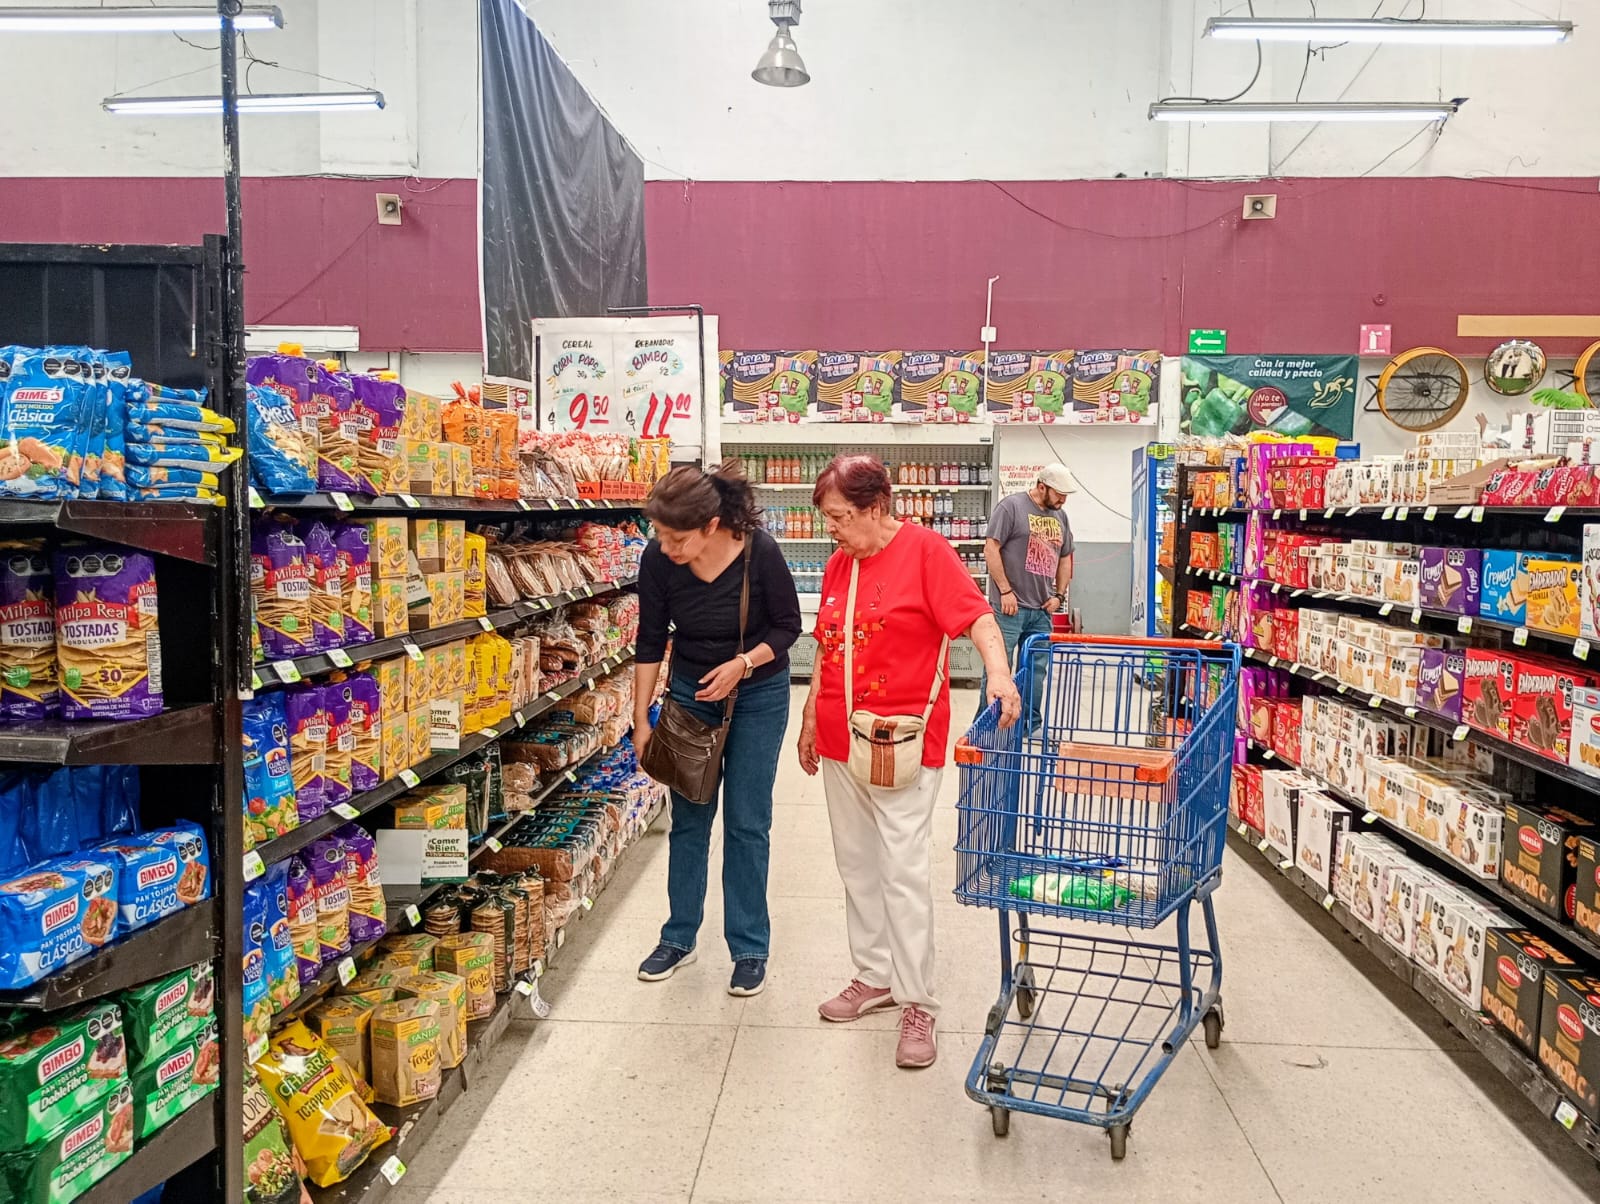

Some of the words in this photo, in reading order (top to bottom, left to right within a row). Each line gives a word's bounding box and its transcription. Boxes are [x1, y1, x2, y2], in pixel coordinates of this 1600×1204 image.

[562, 339, 593, 349] CEREAL
[553, 353, 573, 376] CORN
[632, 350, 668, 371] BIMBO
[1254, 360, 1273, 368] Con
[1274, 360, 1285, 368] la
[1286, 360, 1316, 370] mejor
[1248, 368, 1284, 377] calidad
[1284, 369, 1291, 379] y
[1292, 368, 1323, 379] precio
[9, 409, 55, 424] Clásico
[547, 407, 556, 432] $
[569, 392, 589, 431] 9
[592, 395, 610, 416] 50
[625, 405, 636, 432] $
[640, 392, 674, 440] 11
[675, 392, 691, 413] 00
[274, 566, 301, 580] Milpa
[1529, 567, 1567, 592] EMPERADOR
[0, 604, 40, 621] Milpa
[59, 605, 91, 622] Milpa
[97, 602, 127, 620] Real
[64, 622, 119, 639] TOSTADAS
[67, 637, 116, 646] ONDULADAS
[98, 670, 122, 682] 30
[140, 861, 176, 884] BIMBO
[135, 894, 151, 904] PAN
[151, 883, 178, 899] TOSTADO
[45, 901, 76, 928] BIMBO
[135, 893, 177, 920] CLÁSICO
[41, 939, 53, 950] PAN
[56, 923, 81, 942] TOSTADO
[39, 935, 83, 968] CLÁSICO
[158, 983, 186, 1012] BIMBO
[42, 1042, 81, 1077] BIMBO
[160, 1052, 193, 1081] BIMBO
[41, 1085, 55, 1096] PAN
[57, 1063, 86, 1085] TOSTADO
[296, 1086, 334, 1121] TOTOPOS
[328, 1077, 343, 1094] DE
[65, 1117, 101, 1154] BIMBO
